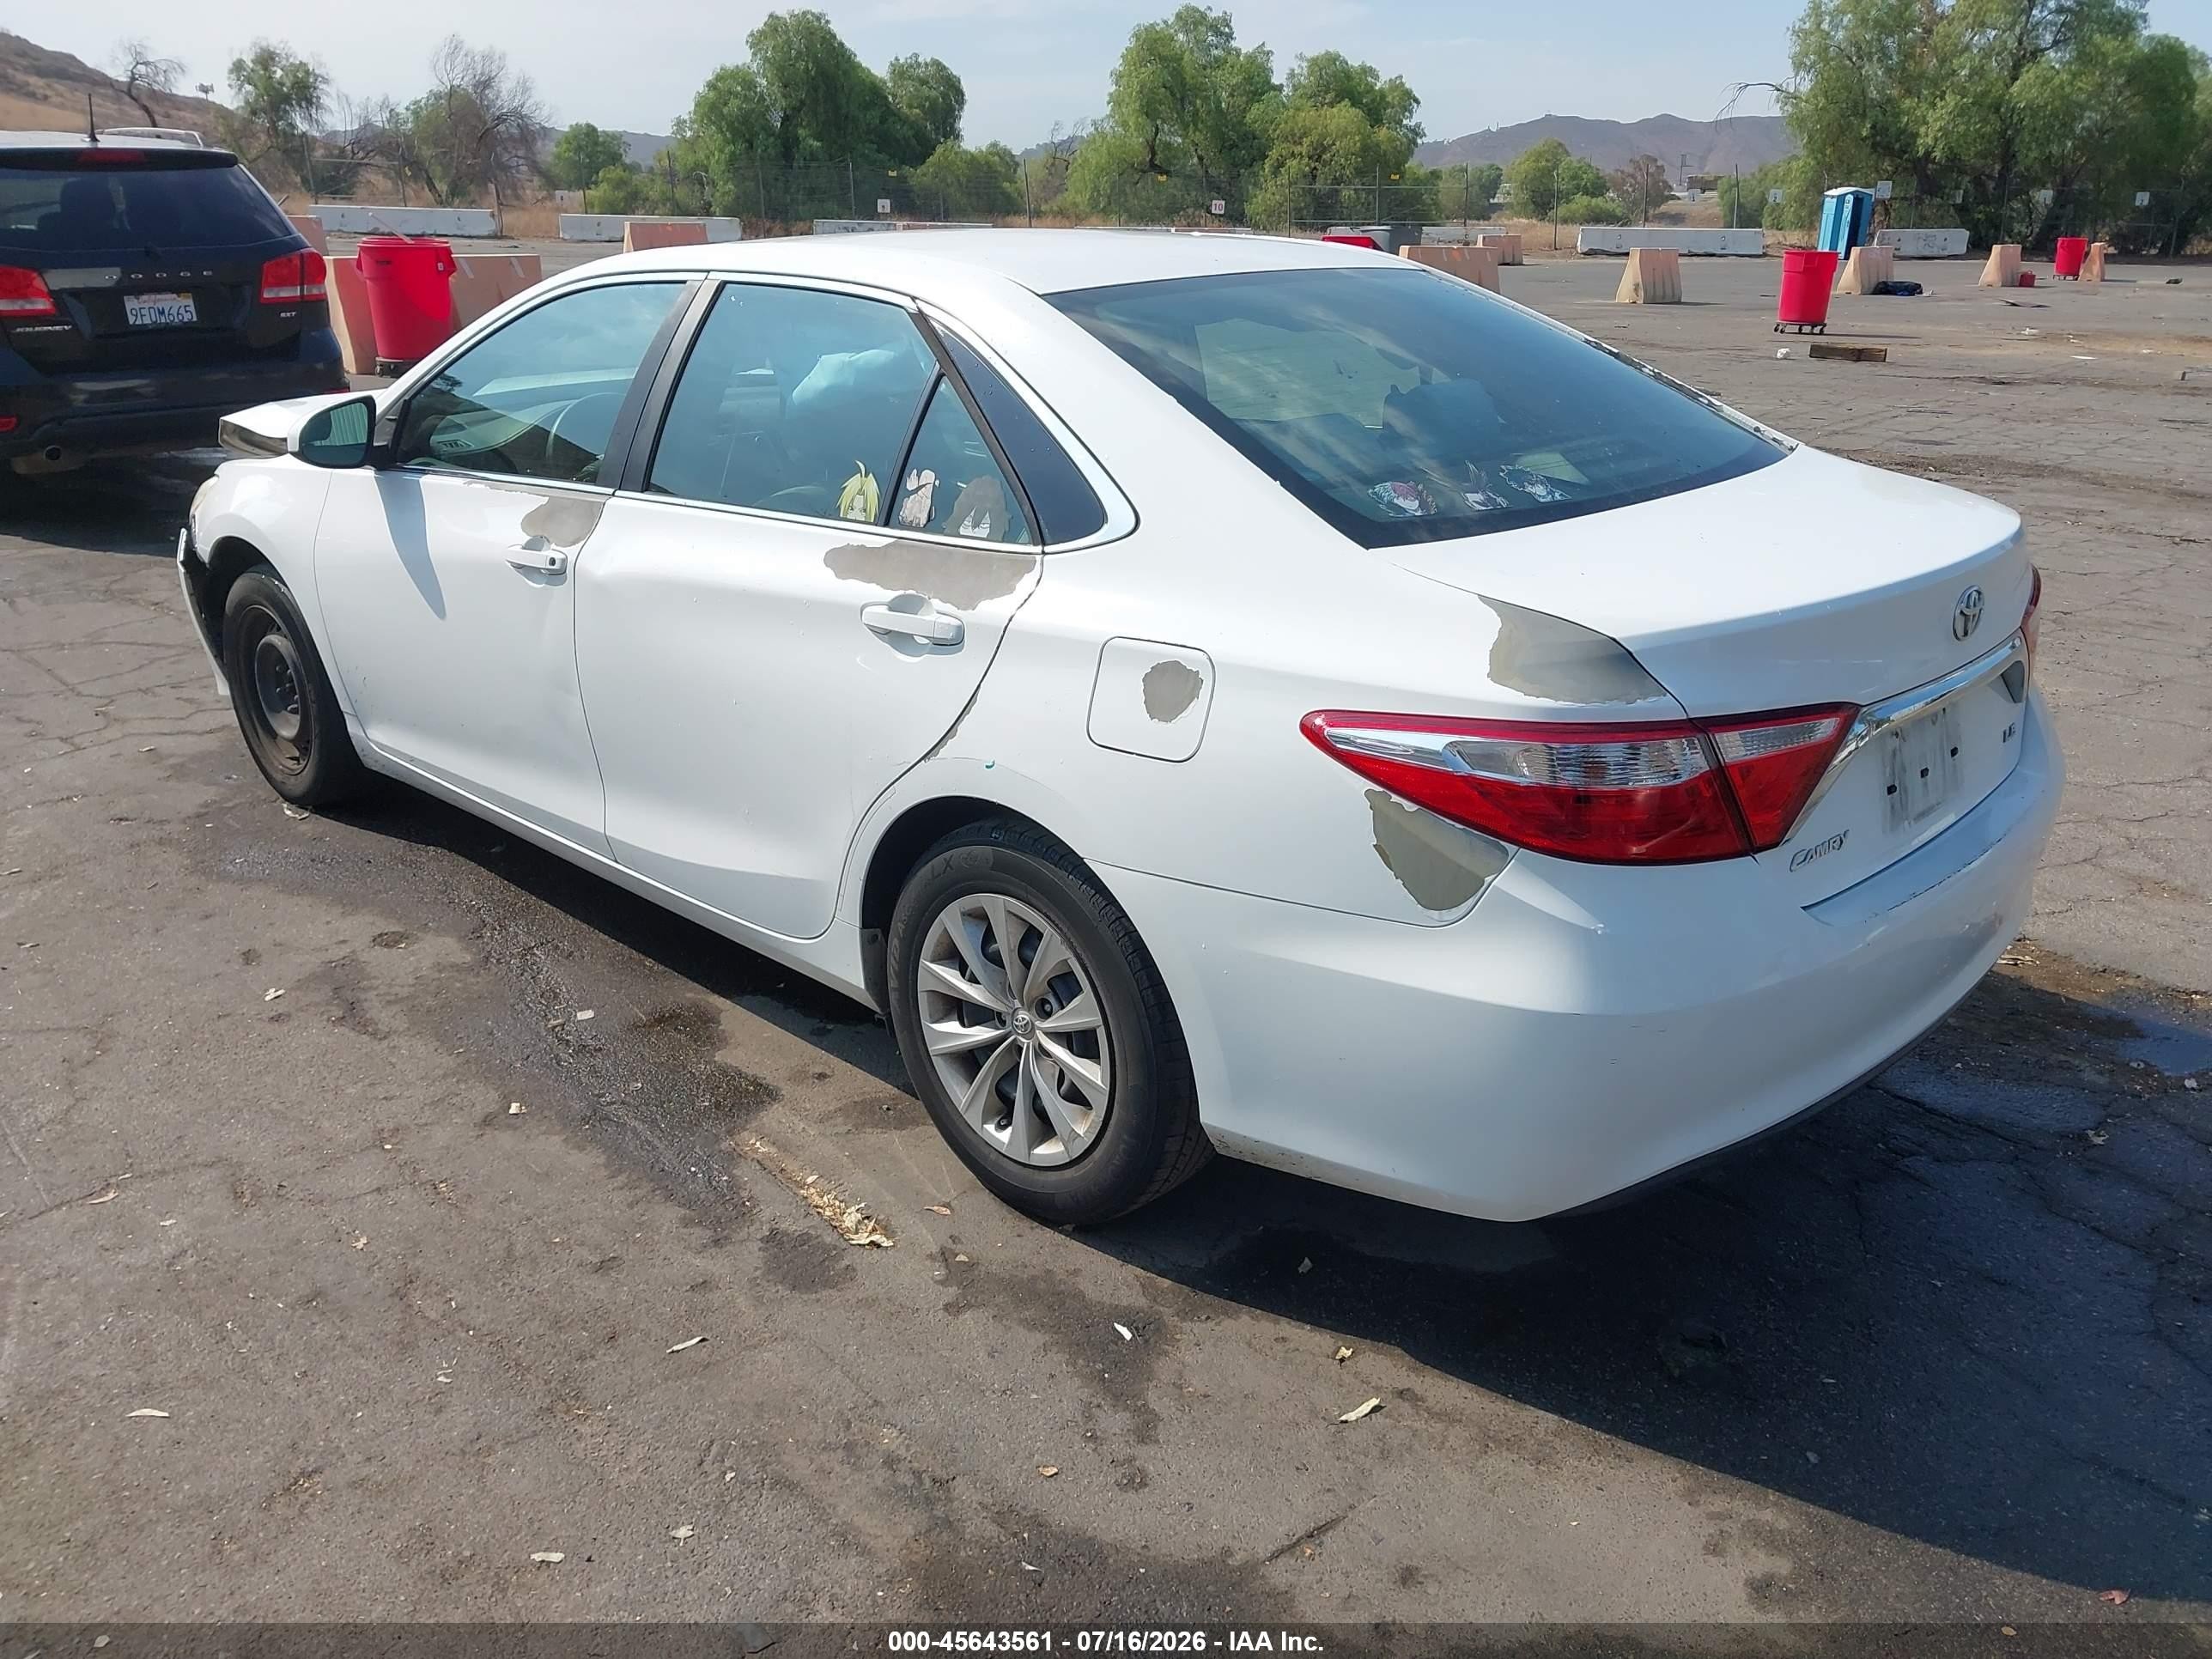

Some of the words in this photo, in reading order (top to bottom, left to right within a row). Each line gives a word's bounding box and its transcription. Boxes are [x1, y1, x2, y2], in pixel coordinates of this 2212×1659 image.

[1213, 203, 1224, 211] 10
[104, 270, 213, 280] DODGE
[1789, 829, 1850, 873] CAMRY
